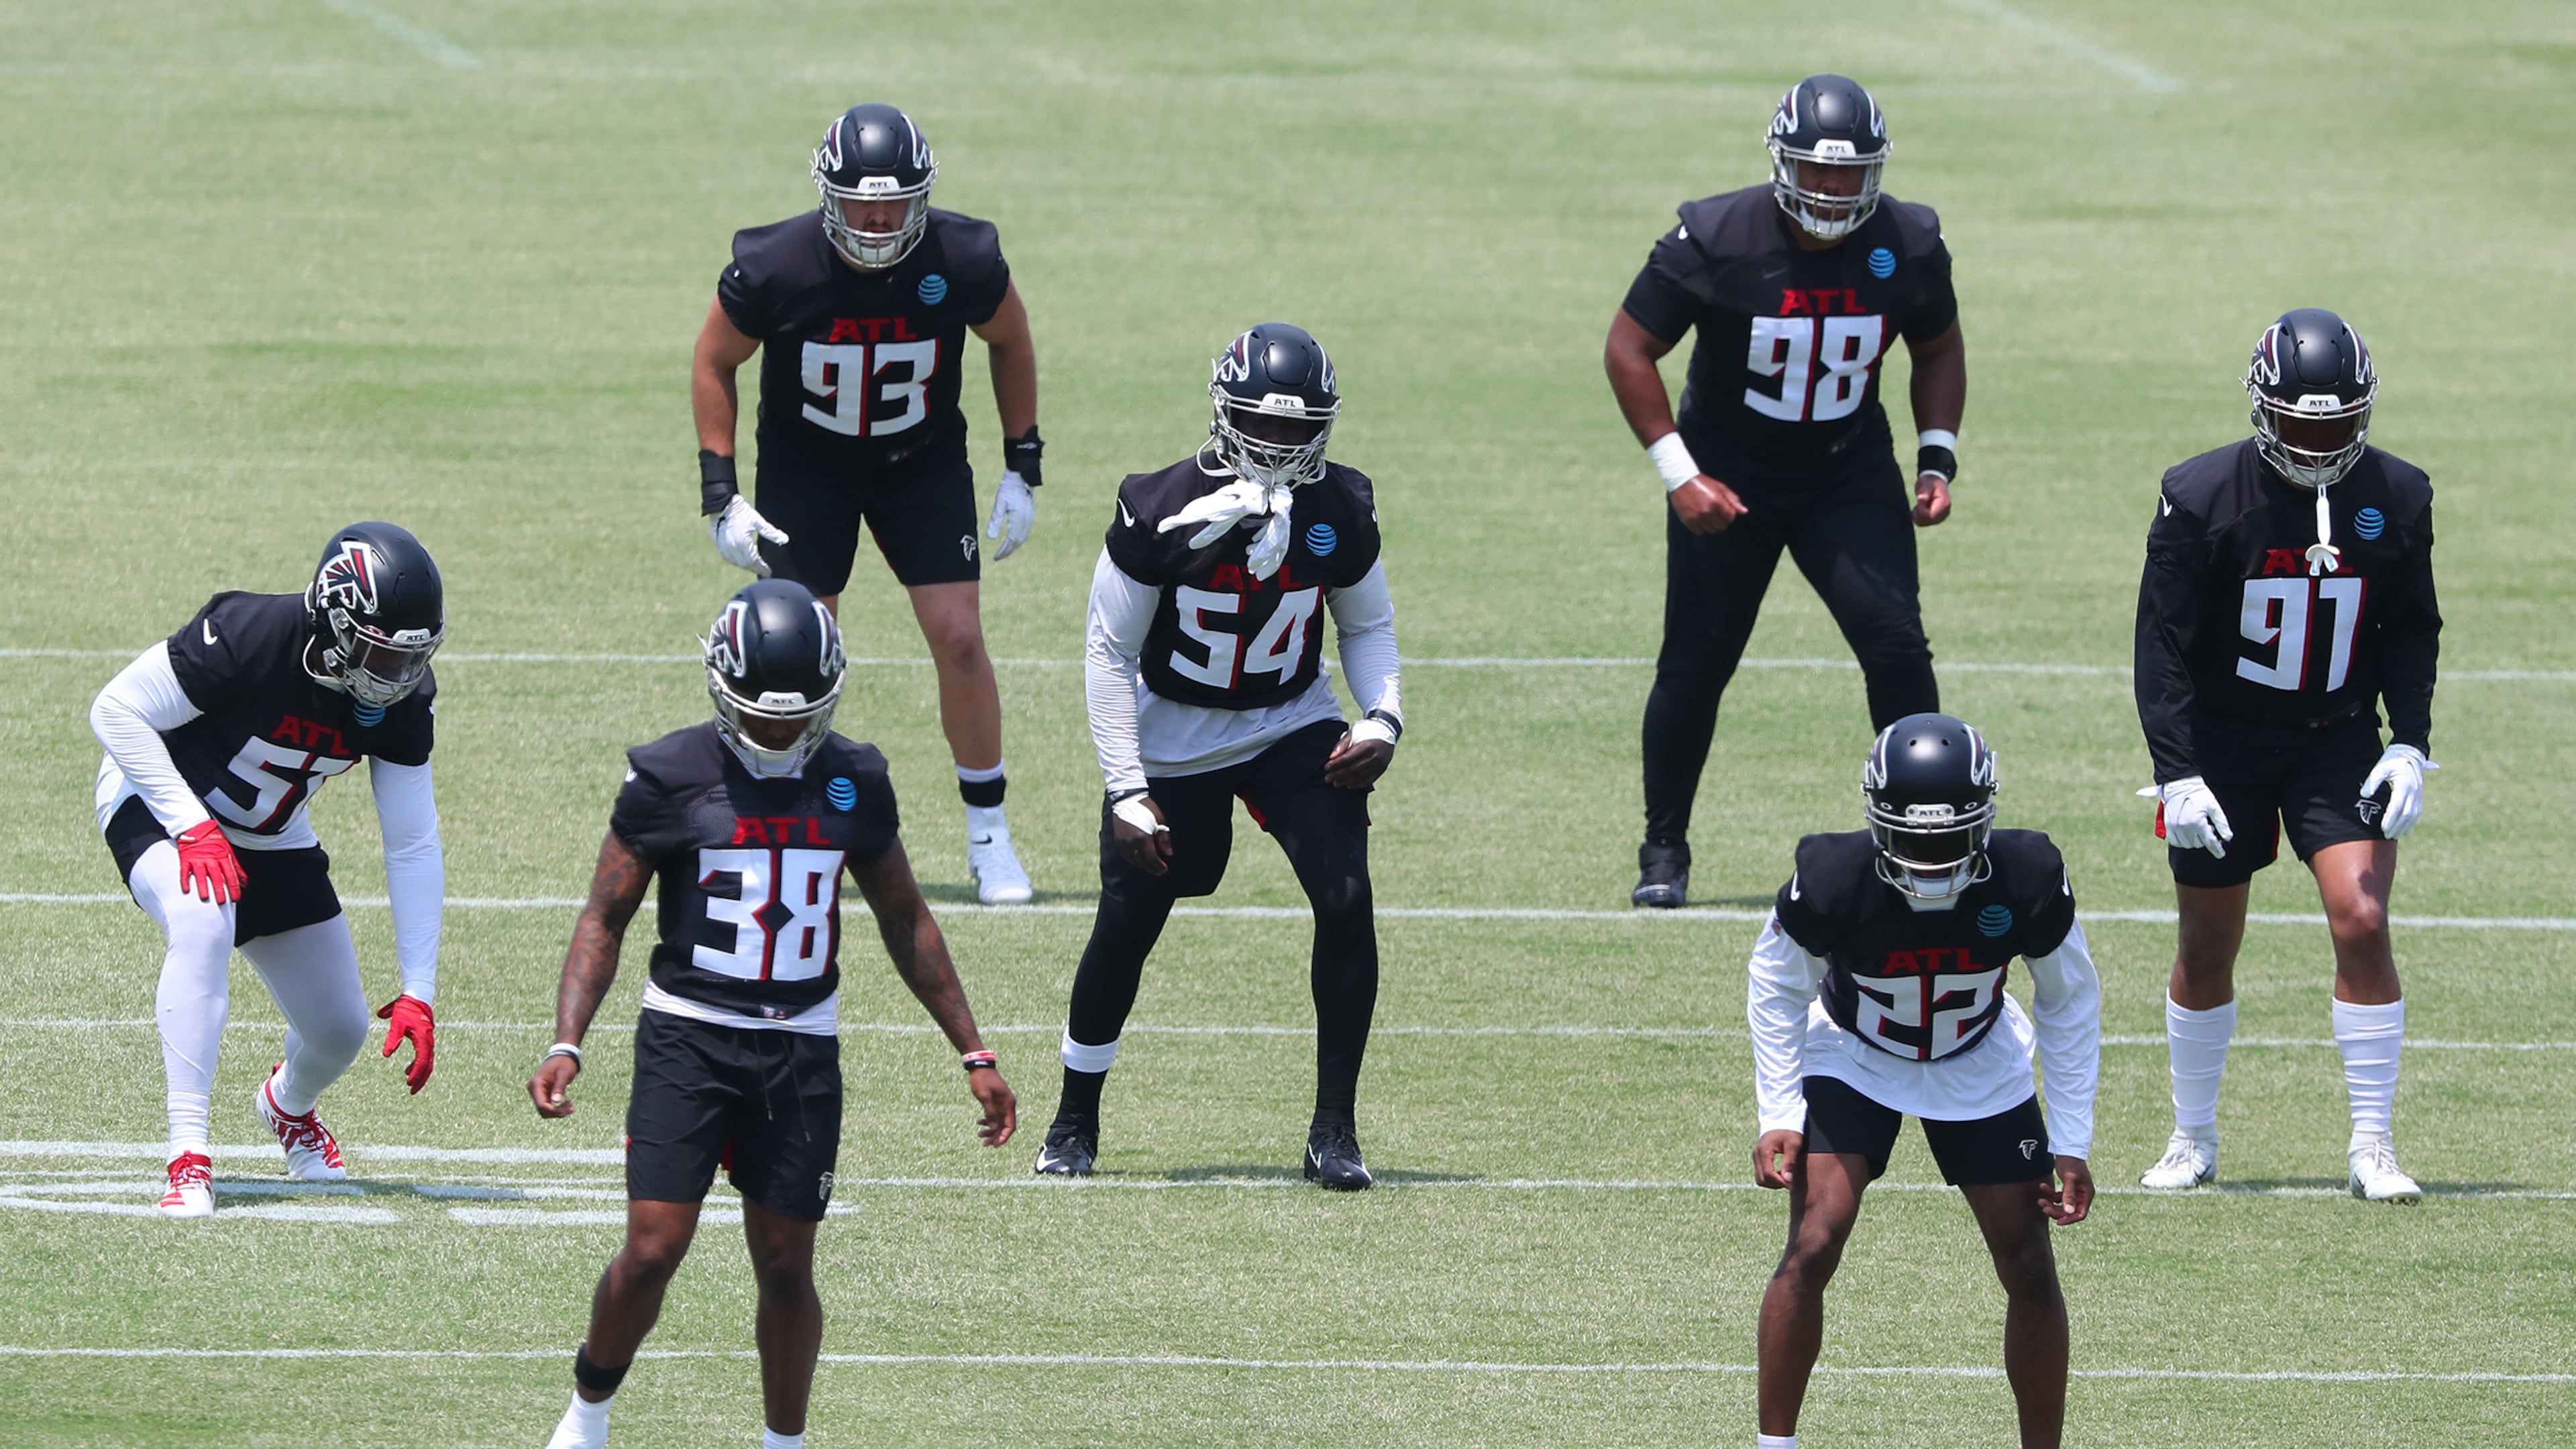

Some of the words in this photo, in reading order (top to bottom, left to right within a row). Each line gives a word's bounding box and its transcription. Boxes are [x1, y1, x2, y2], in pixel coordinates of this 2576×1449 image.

[828, 317, 916, 342] ATL
[1778, 288, 1866, 316] ATL
[800, 338, 941, 437] 93
[1275, 398, 1295, 407] ATL
[1743, 314, 1886, 422] 98
[1169, 584, 1325, 690] 54
[2236, 577, 2367, 692] 91
[271, 714, 350, 755] ATL
[731, 816, 831, 845] ATL
[692, 848, 848, 981] 38
[1882, 947, 1984, 975] ATL
[1851, 964, 2006, 1061] 22
